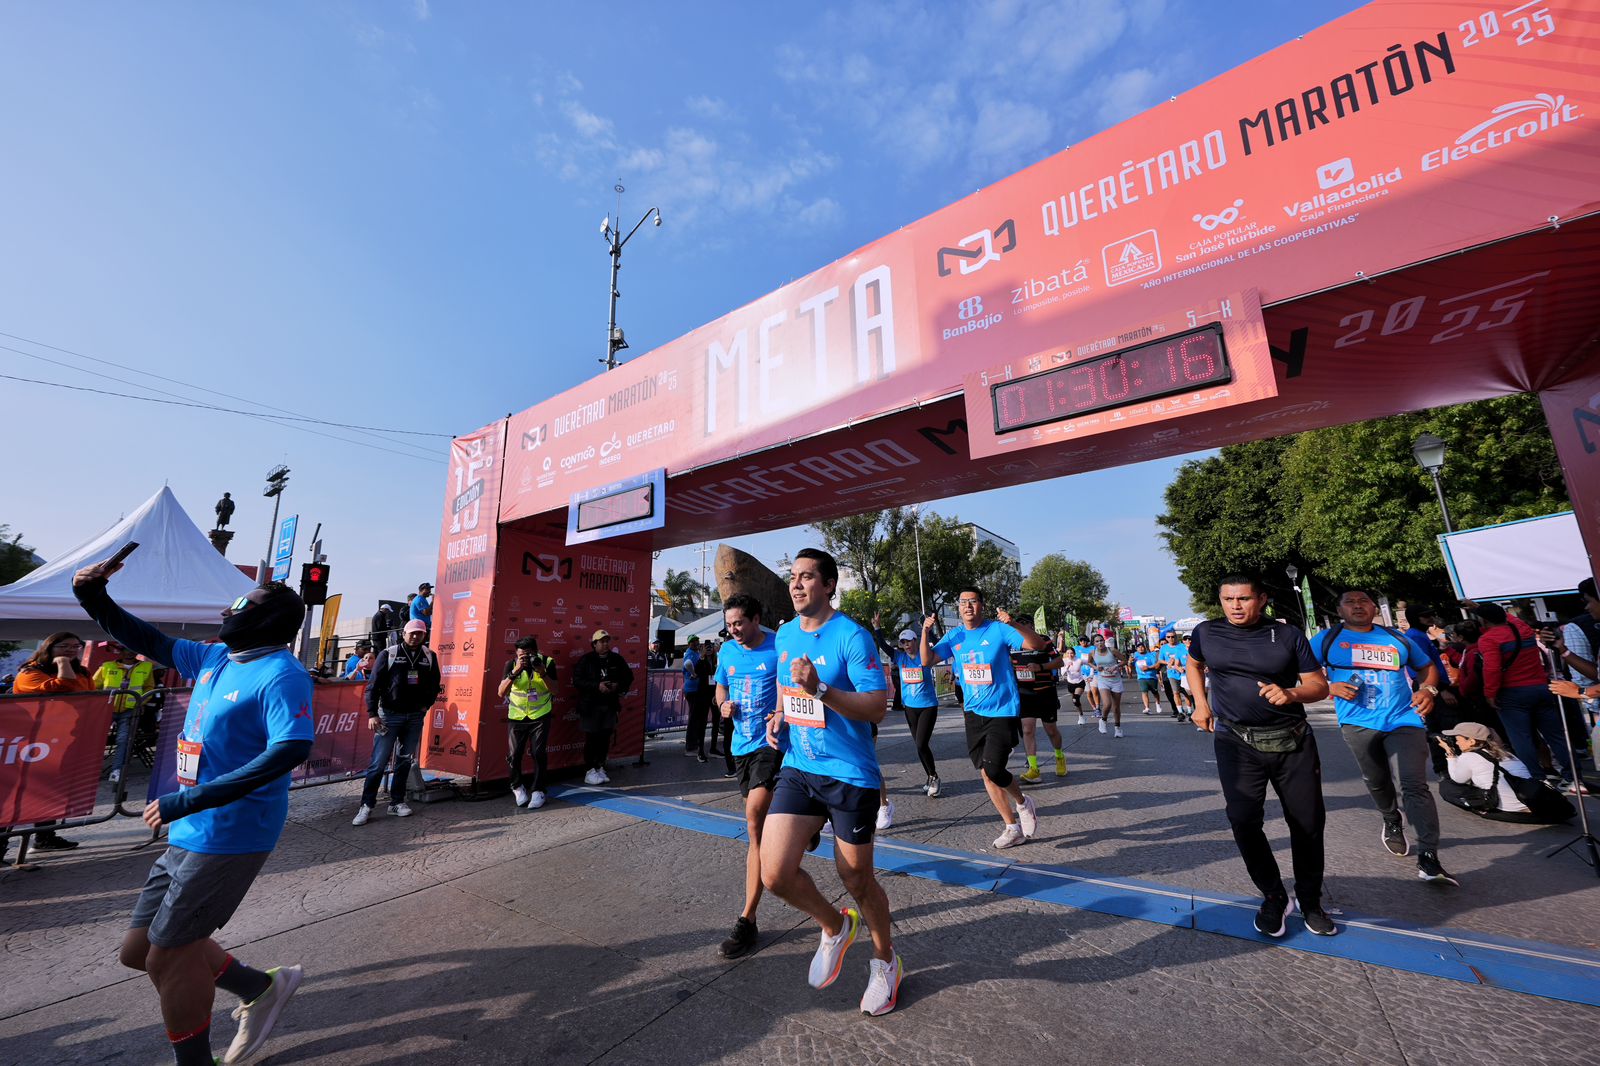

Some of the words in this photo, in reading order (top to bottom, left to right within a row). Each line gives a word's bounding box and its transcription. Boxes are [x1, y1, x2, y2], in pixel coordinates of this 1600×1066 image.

[1041, 129, 1228, 236] QUERÉTARO
[1239, 31, 1456, 156] MARATÓN
[1421, 103, 1580, 172] Electrolit
[1283, 166, 1404, 218] Valladolid
[1299, 210, 1325, 223] Caja
[1327, 188, 1389, 214] Financiera
[1175, 252, 1197, 264] San
[1198, 242, 1225, 257] José
[1226, 224, 1277, 247] Iturbide
[1189, 237, 1212, 251] CAJA
[1213, 221, 1258, 240] POPULAR
[1111, 260, 1155, 280] MEXICANA
[1162, 255, 1236, 283] INTERNACIONAL
[1237, 249, 1251, 260] DE
[1252, 242, 1273, 255] LAS
[1010, 259, 1089, 305] zibatá
[942, 312, 1003, 341] BanBajío
[1076, 336, 1117, 356] QUERÉTARO
[1117, 326, 1153, 345] MARATÓN
[706, 263, 897, 436] META
[554, 398, 605, 438] QUERÉTARO
[608, 375, 658, 416] MARATÓN
[626, 419, 675, 447] QUERÉTARO
[446, 534, 488, 561] QUERÉTARO
[444, 554, 486, 585] MARATÓN
[580, 554, 628, 575] QUERÉTARO
[579, 571, 628, 593] MARATÓN
[1361, 649, 1393, 663] 12405
[790, 696, 815, 715] 6980
